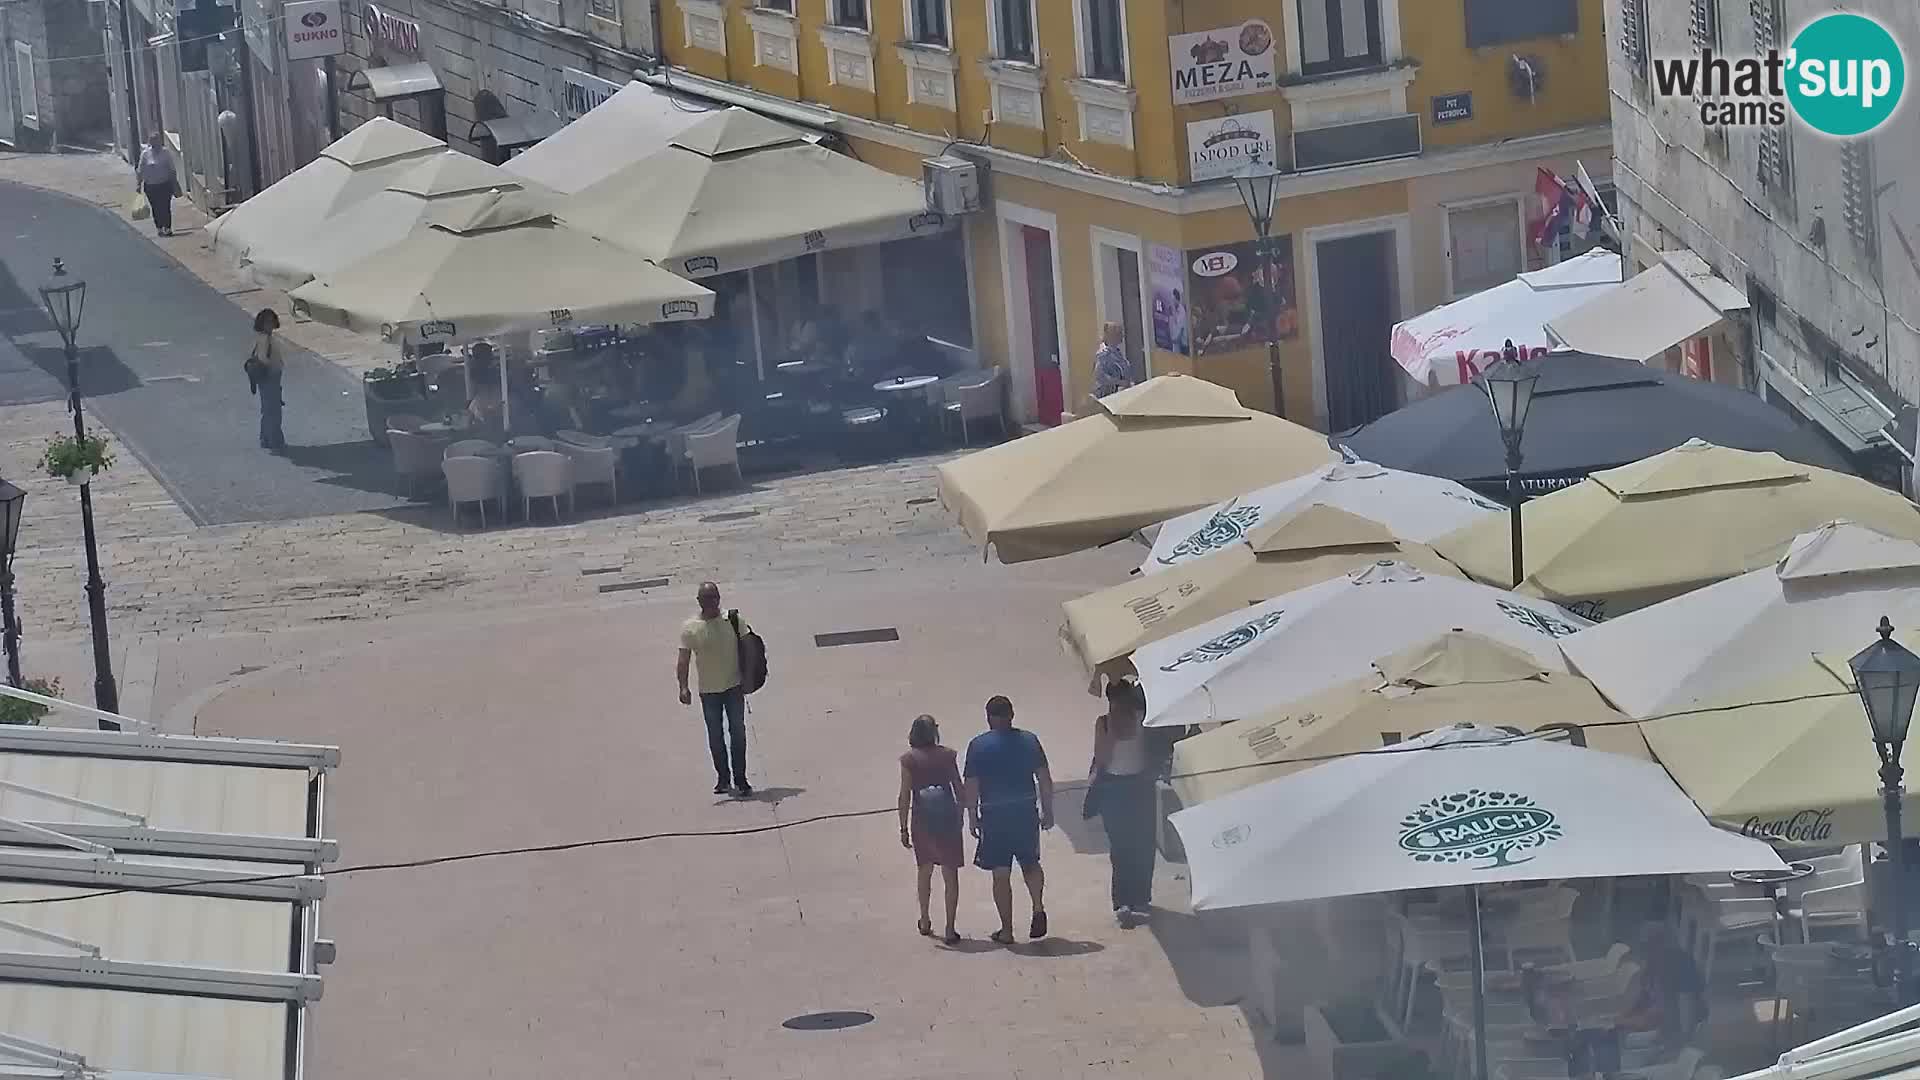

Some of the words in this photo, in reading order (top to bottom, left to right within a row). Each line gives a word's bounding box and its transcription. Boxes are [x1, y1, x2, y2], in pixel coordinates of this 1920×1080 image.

[293, 29, 338, 43] SUKNO
[1176, 60, 1255, 90] MEZA
[1194, 145, 1240, 164] ISPOD
[1437, 812, 1537, 843] RAUCH
